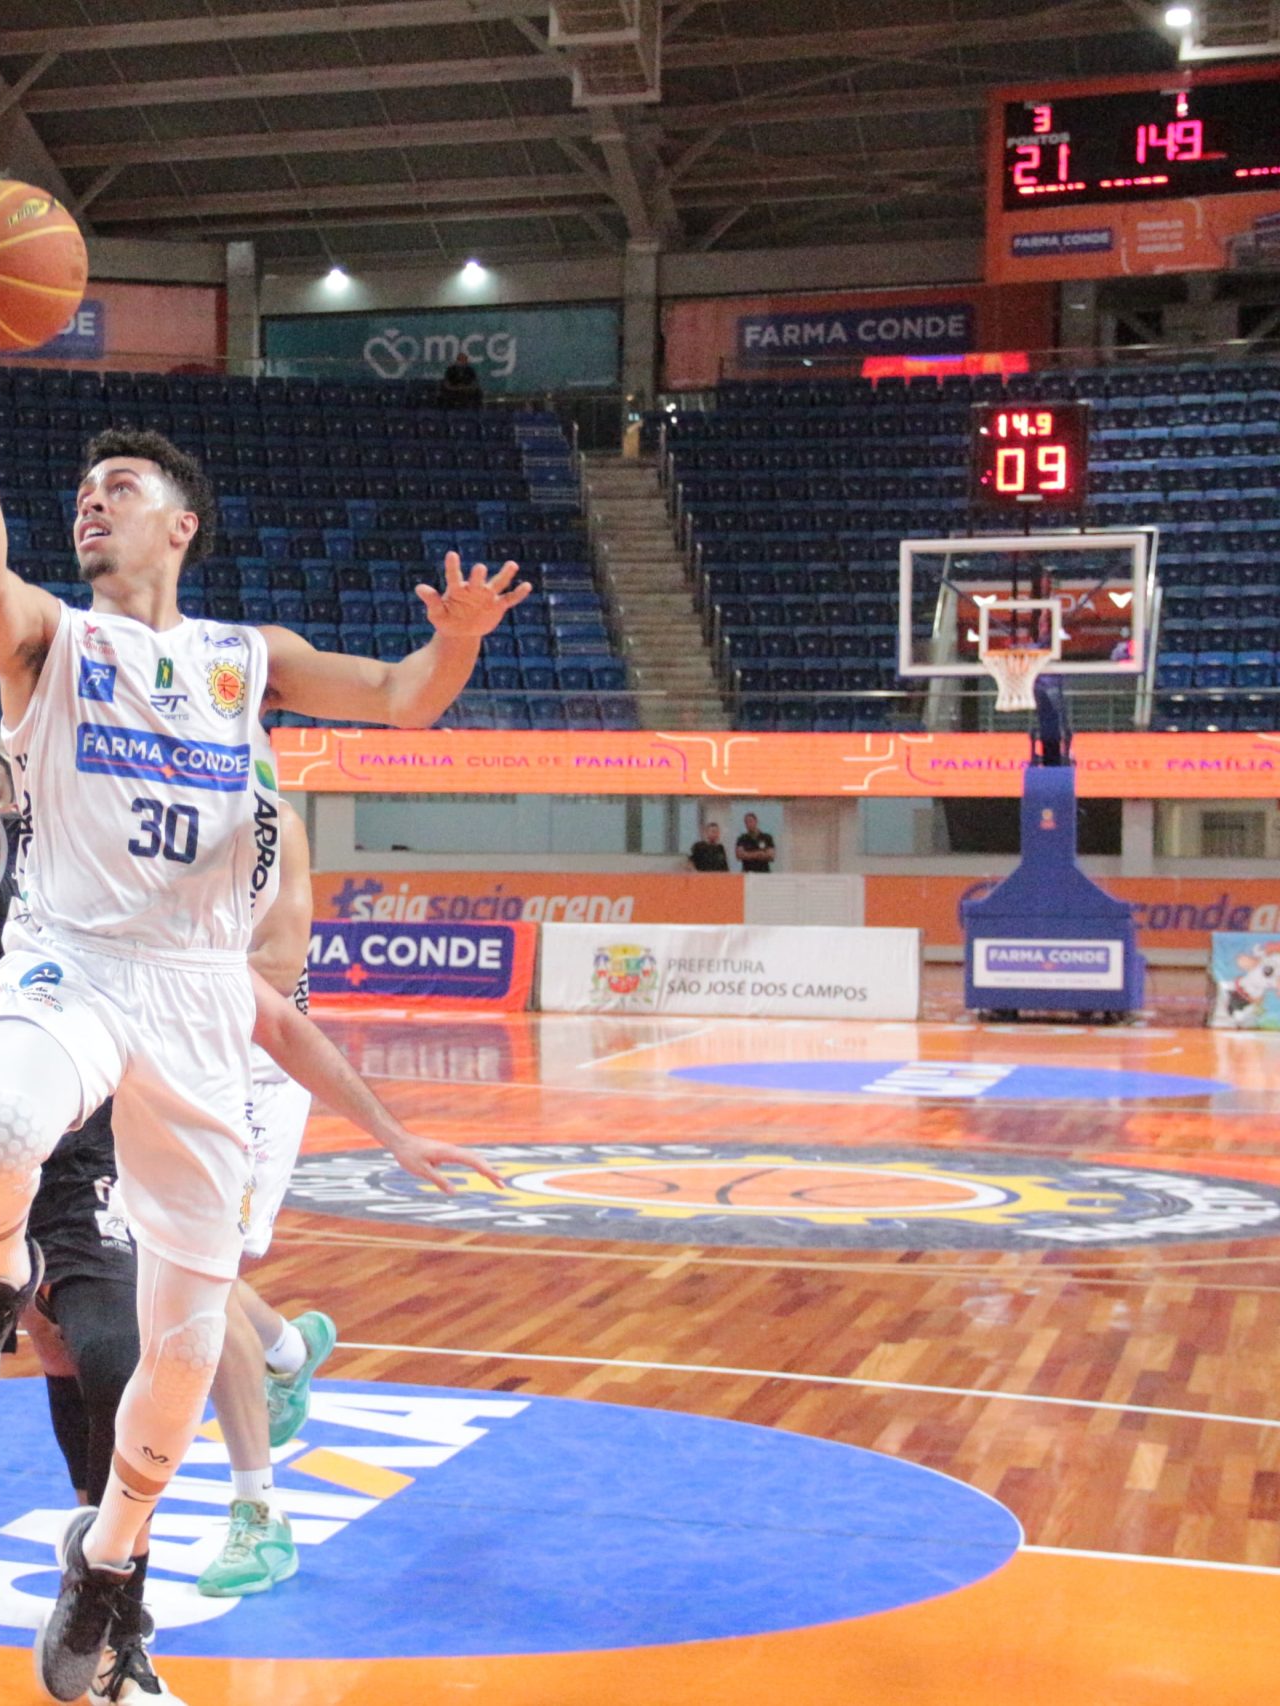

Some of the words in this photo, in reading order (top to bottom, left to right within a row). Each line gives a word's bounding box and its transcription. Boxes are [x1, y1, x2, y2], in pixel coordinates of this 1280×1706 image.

[1033, 105, 1052, 133] 3
[1006, 131, 1070, 148] PONTOS
[1013, 144, 1070, 185] 21
[1013, 233, 1060, 249] FARMA
[1063, 231, 1110, 246] CONDE
[744, 321, 849, 348] FARMA
[857, 313, 966, 342] CONDE
[423, 331, 517, 378] mcg
[996, 445, 1067, 493] 09
[83, 731, 164, 764] FARMA
[172, 746, 250, 774] CONDE
[358, 752, 455, 768] FAMÍLIA
[466, 755, 530, 768] CUIDA
[573, 753, 672, 769] FAMÍLIA
[1166, 756, 1274, 771] FAMÍLIA
[128, 797, 199, 864] 30
[361, 934, 503, 969] CONDE
[989, 948, 1044, 962] FARMA
[1048, 949, 1107, 964] CONDE
[669, 958, 765, 974] PREFEITURA
[667, 976, 702, 996] SÃO
[704, 977, 746, 997] JOSÉ
[751, 981, 787, 998] DOS
[792, 983, 868, 1002] CAMPOS
